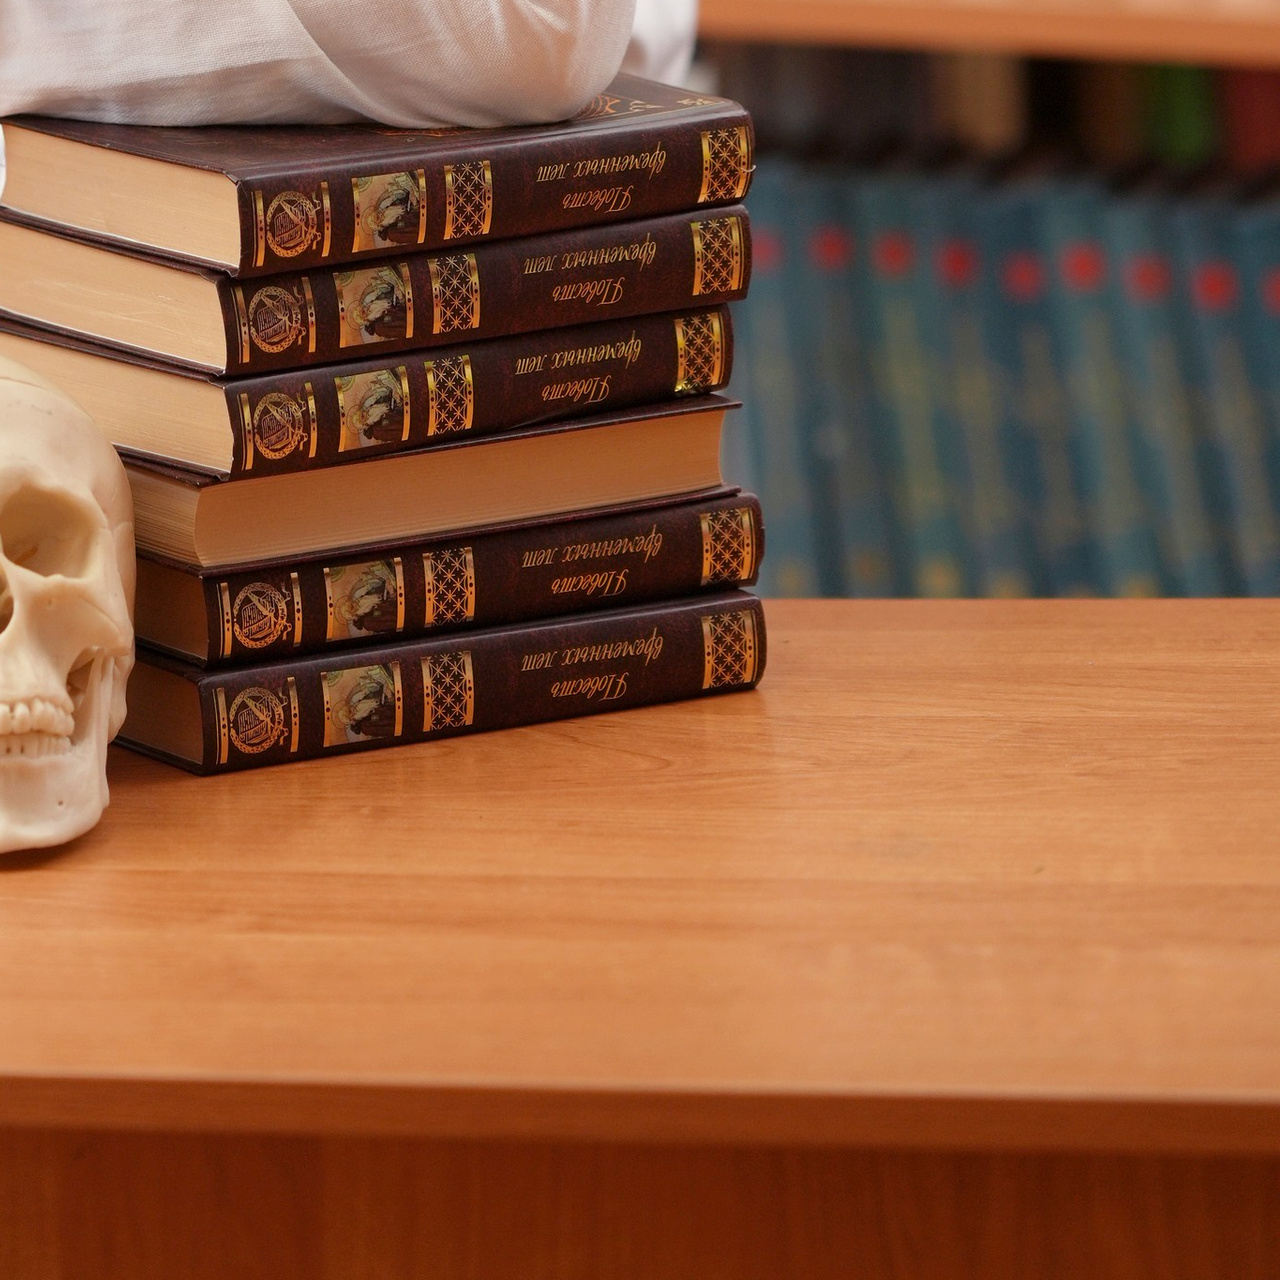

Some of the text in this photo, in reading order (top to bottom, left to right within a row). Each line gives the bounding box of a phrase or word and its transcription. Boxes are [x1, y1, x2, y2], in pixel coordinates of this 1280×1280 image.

[536, 140, 667, 183] временных лет
[562, 185, 635, 215] Повесть
[523, 232, 657, 275] временных лет
[552, 277, 625, 306] Повесть
[514, 330, 642, 375] временных лет
[541, 374, 612, 405] Повесть
[521, 524, 663, 568] временных лет
[551, 568, 629, 598] Повесть
[521, 627, 664, 672] временных лет
[550, 671, 629, 702] Повесть
